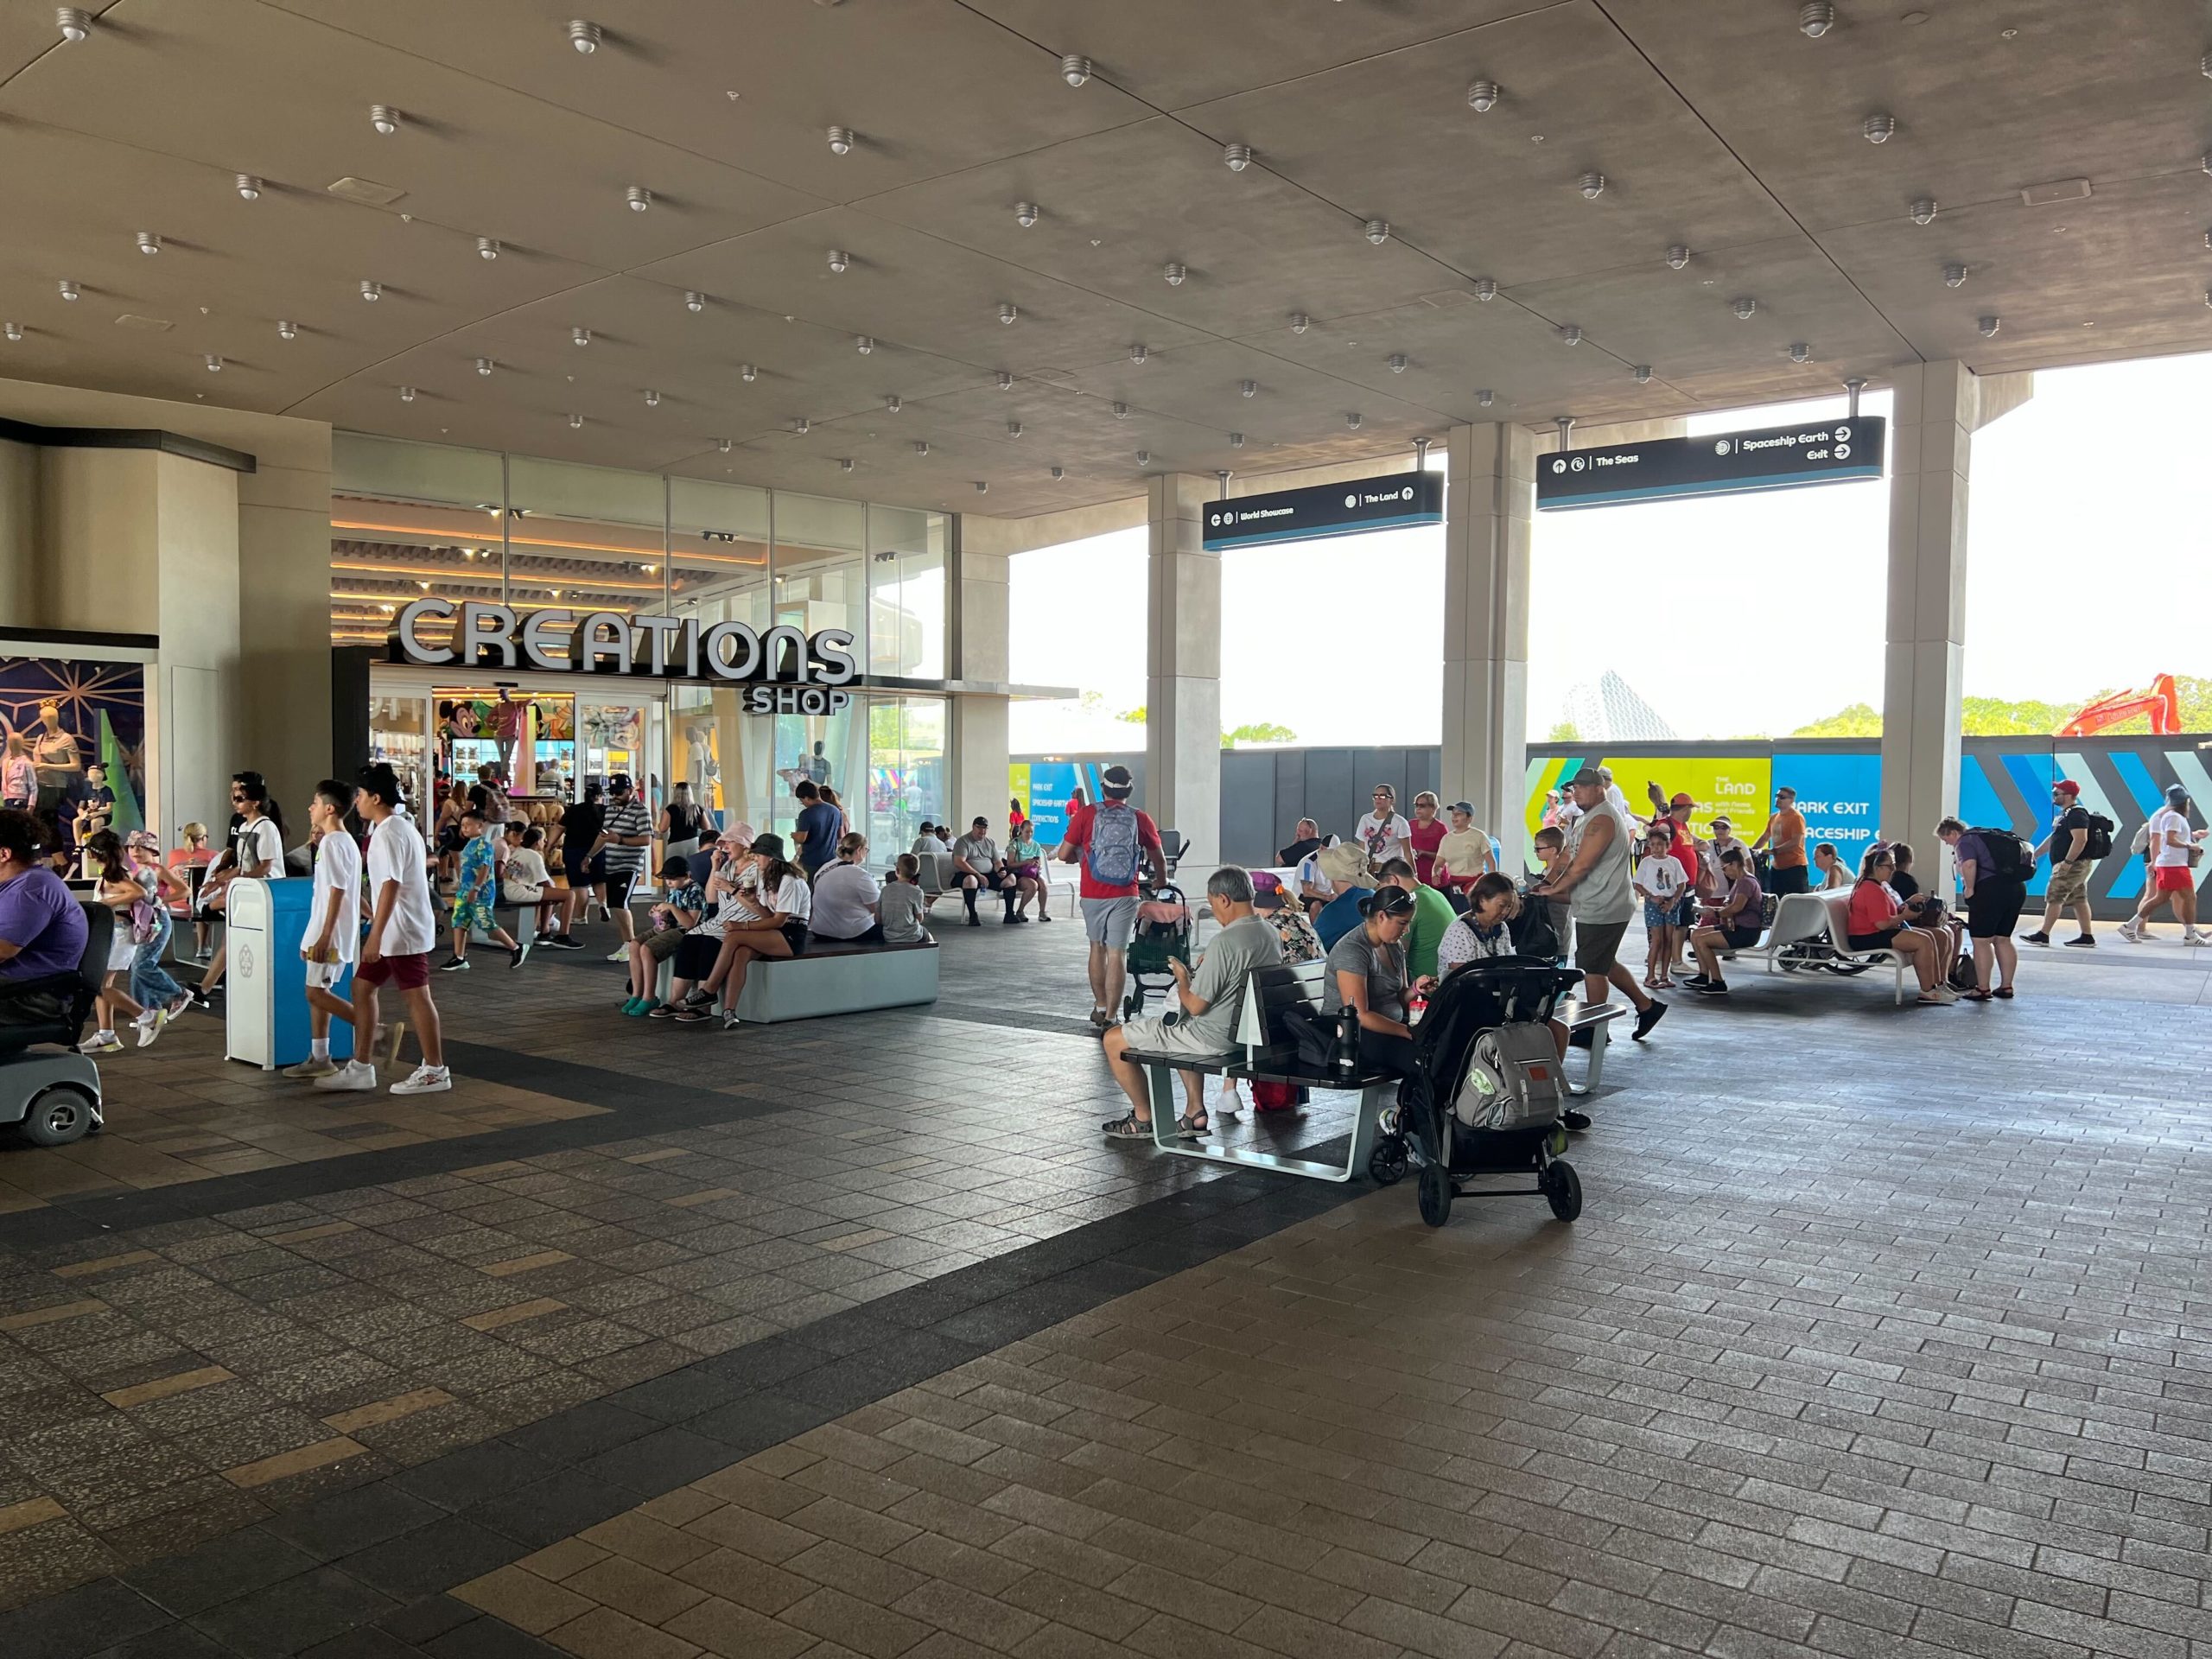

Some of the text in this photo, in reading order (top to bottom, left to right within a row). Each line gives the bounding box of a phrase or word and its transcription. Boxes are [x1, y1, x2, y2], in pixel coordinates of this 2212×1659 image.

[1743, 431, 1829, 451] Spaceship Earth
[1596, 454, 1639, 466] The Seas
[1807, 449, 1828, 460] Exit
[1364, 491, 1399, 503] The Land
[1240, 508, 1294, 520] World Showcase
[396, 597, 855, 684] CREATIONS
[750, 686, 849, 716] SHOP
[1714, 782, 1757, 795] LAND
[1833, 802, 1870, 815] EXIT
[1804, 827, 1871, 841] ACESHIP
